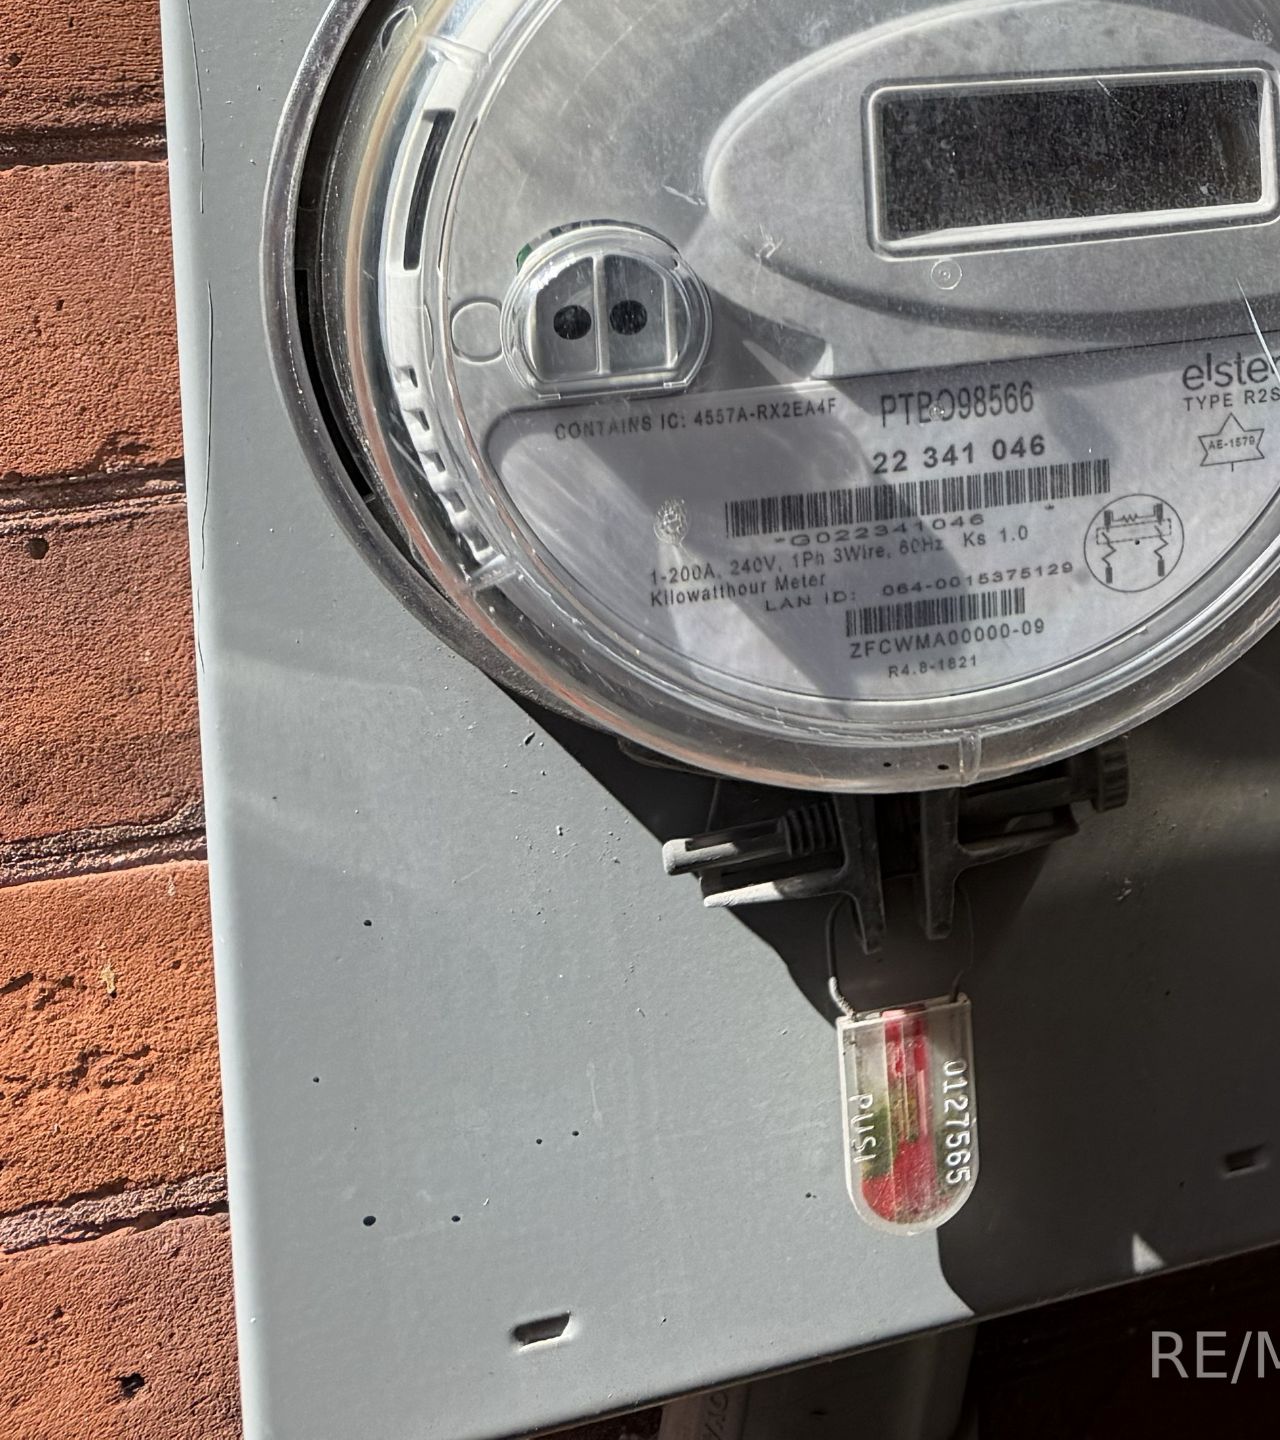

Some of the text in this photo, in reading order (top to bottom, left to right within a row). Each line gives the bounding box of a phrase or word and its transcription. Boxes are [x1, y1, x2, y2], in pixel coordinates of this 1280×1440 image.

[554, 396, 838, 441] CONTAINS IC: 4557A-RX2EA4F
[1182, 392, 1234, 413] TYPE
[872, 434, 1046, 476] 22 341 046
[650, 524, 1029, 586] 1-200A, 240V, 1Ph 3Wire, 60Hz Ks 1.0
[650, 572, 826, 608] Kilowatthour Meter
[765, 595, 812, 612] LAN
[882, 561, 1074, 597] 064-0015375129
[850, 617, 1046, 659] ZFCWMA00000-09
[942, 1058, 973, 1185] 0127565
